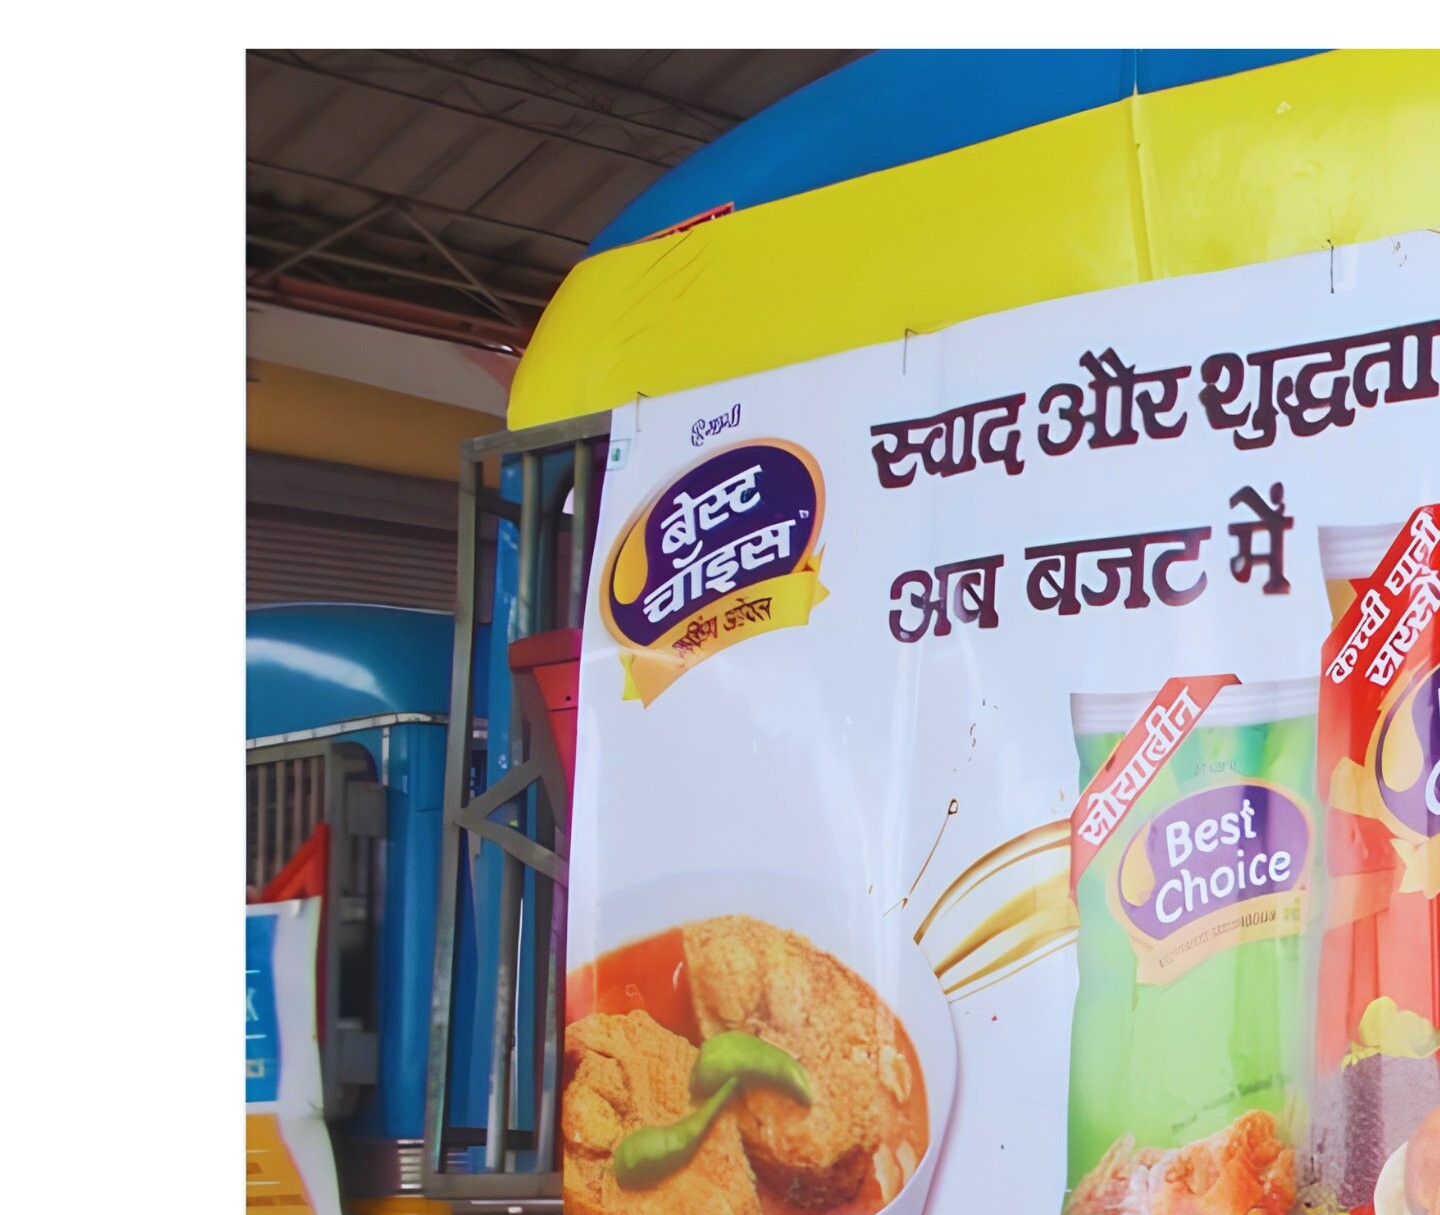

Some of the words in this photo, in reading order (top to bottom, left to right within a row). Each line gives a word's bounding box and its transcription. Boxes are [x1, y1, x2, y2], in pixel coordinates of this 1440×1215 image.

[871, 392, 1026, 489] स्वाद
[1037, 347, 1191, 456] और
[661, 464, 763, 554] बेस्ट
[643, 539, 797, 623] चॉइस
[889, 554, 1004, 644] अब
[1025, 525, 1212, 616] बजट
[1228, 482, 1295, 595] में
[1166, 799, 1257, 867] Best
[1155, 849, 1291, 924] Choice
